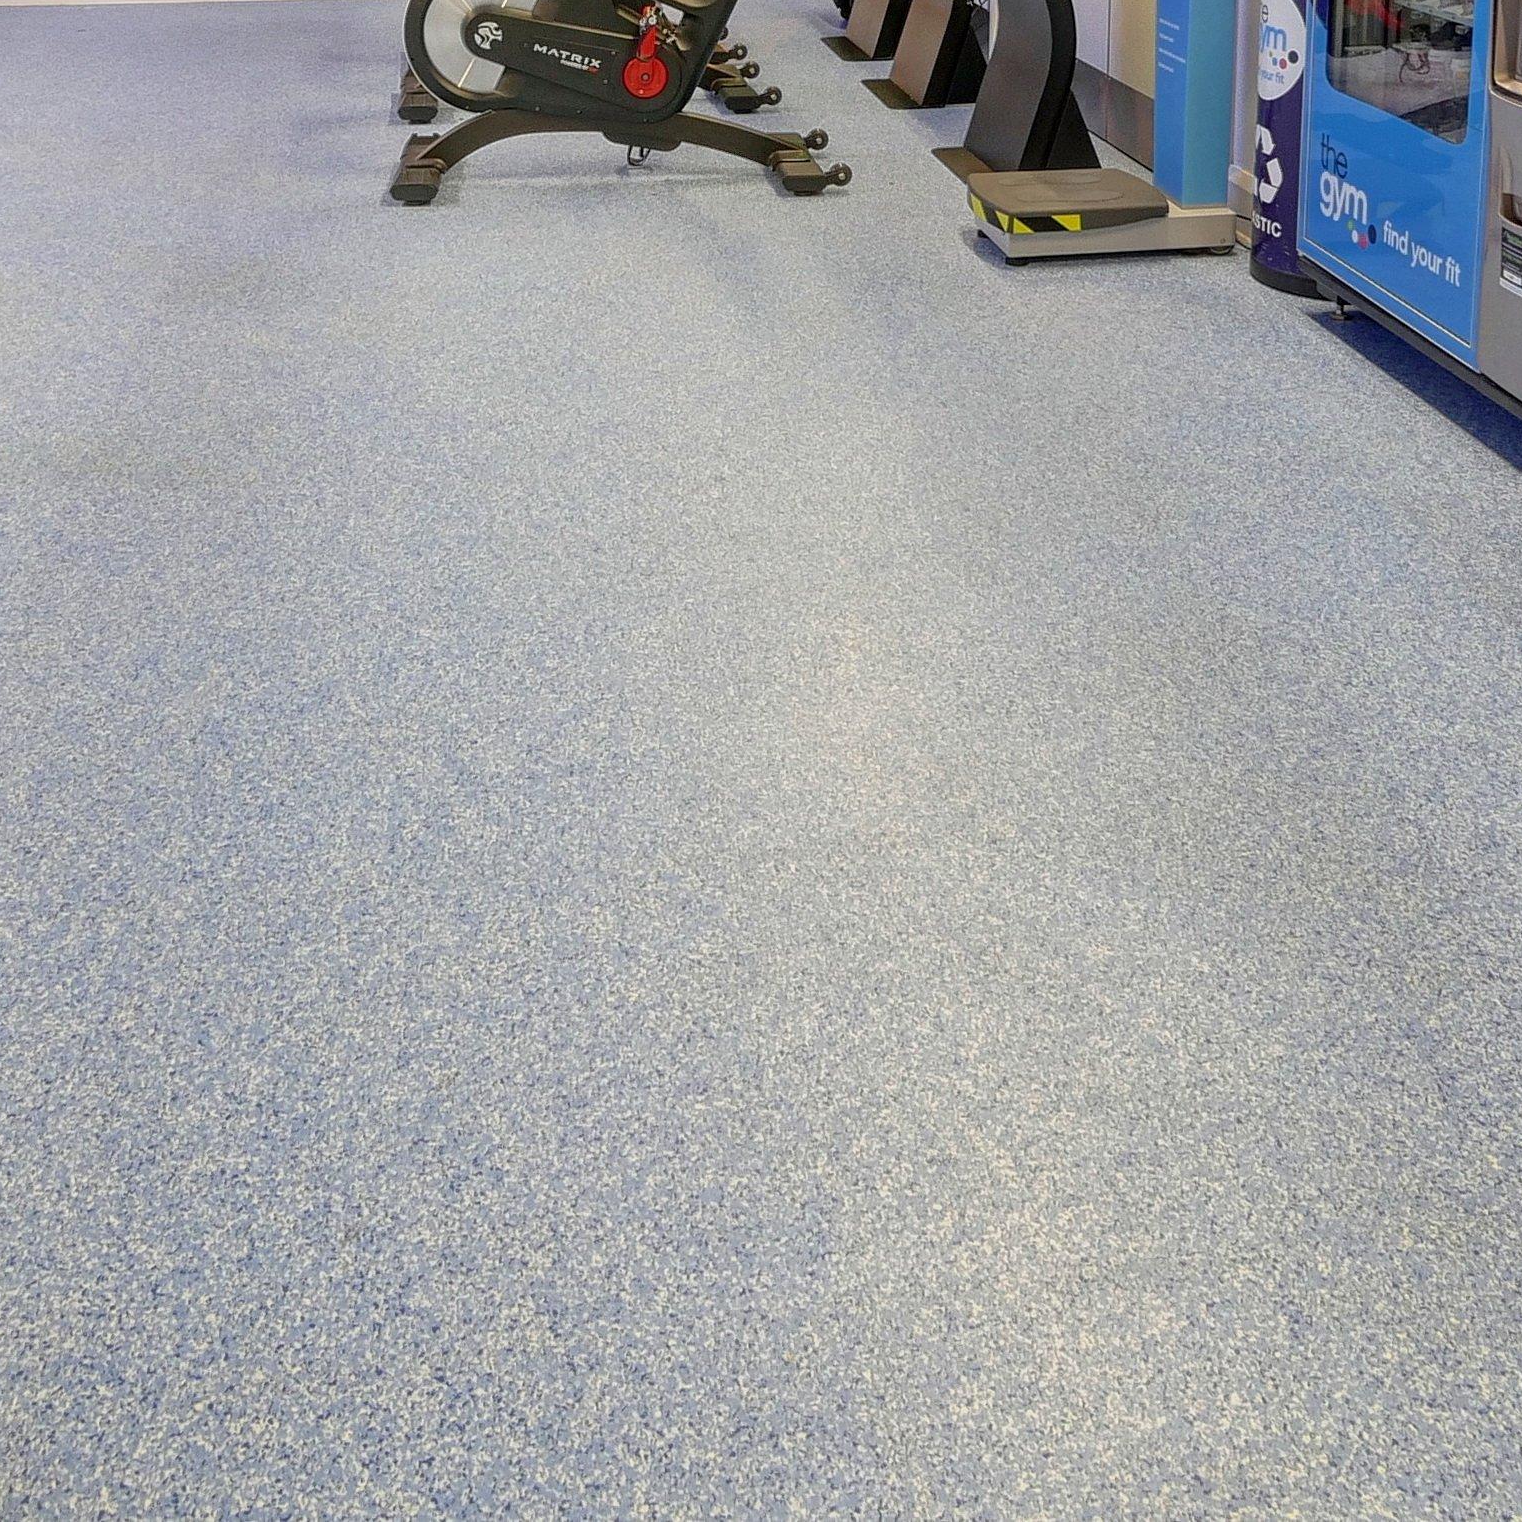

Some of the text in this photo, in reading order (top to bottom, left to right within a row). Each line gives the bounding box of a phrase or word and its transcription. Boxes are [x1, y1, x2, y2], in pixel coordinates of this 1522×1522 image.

[534, 43, 601, 69] MATRIX
[1321, 133, 1348, 179] the
[1319, 171, 1368, 225] gym
[1252, 211, 1283, 238] STIC
[1383, 220, 1461, 288] find your fit
